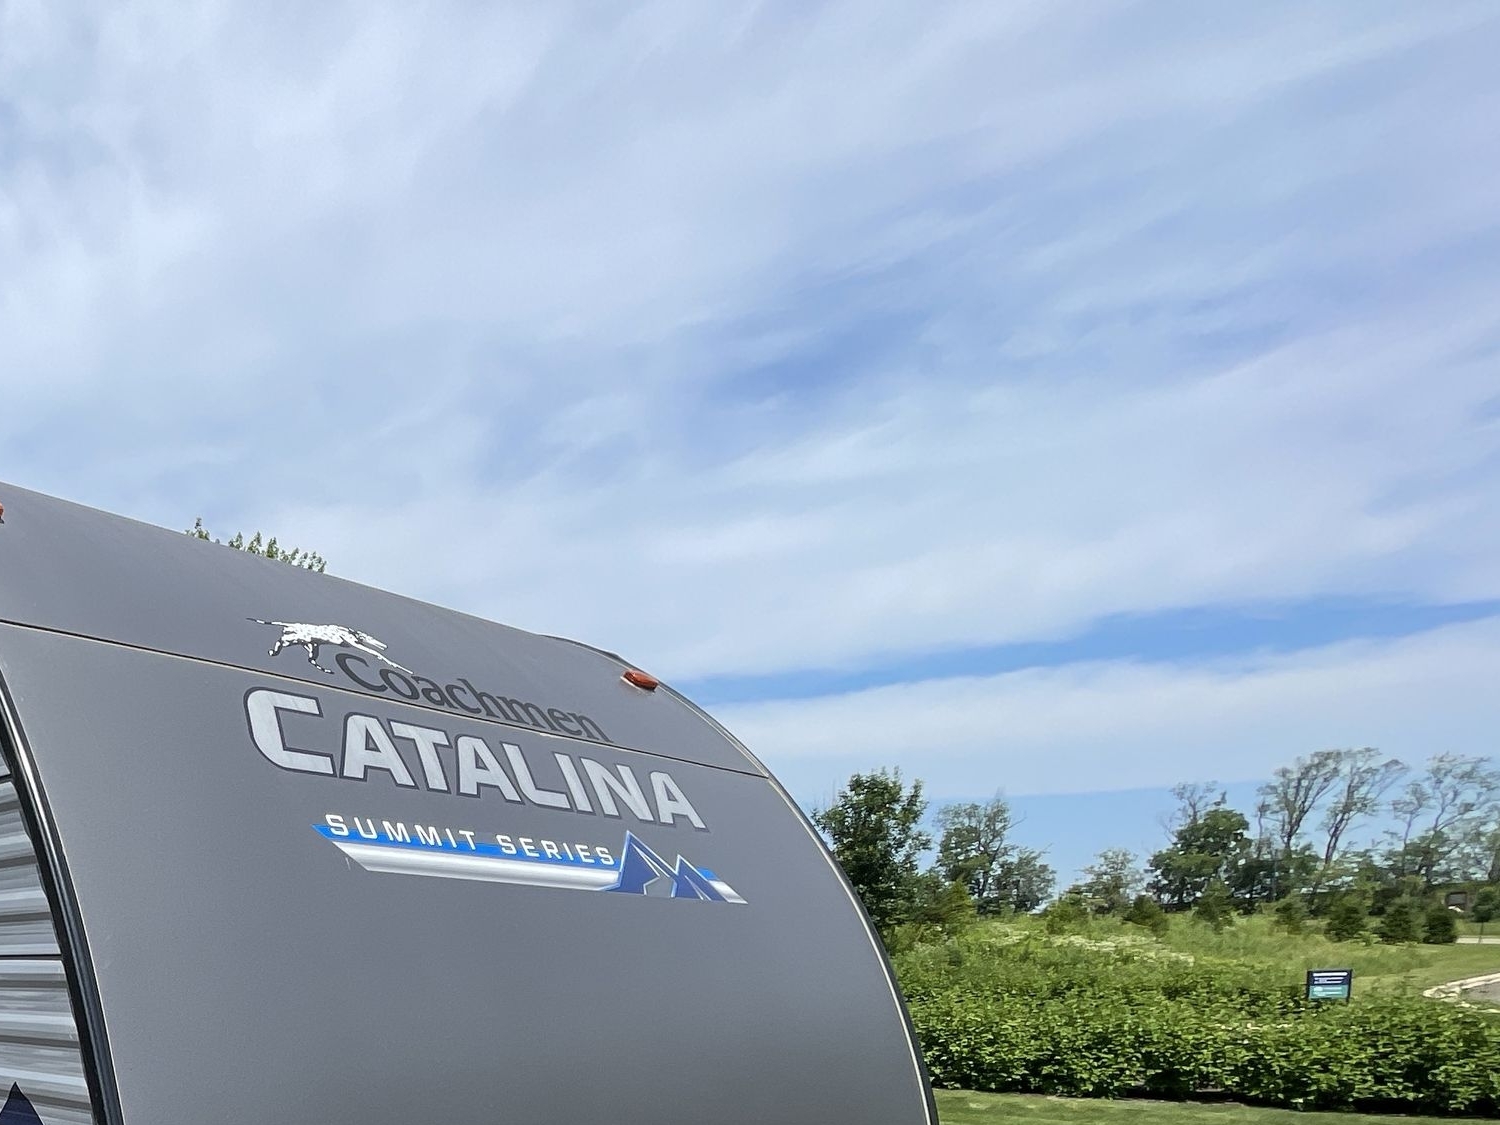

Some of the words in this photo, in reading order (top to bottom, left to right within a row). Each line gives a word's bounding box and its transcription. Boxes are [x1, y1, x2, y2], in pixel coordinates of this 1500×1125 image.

[335, 653, 613, 743] Coachmen
[244, 687, 708, 831] CATALINA
[325, 814, 476, 850] SUMMIT
[496, 834, 615, 866] SERIES
